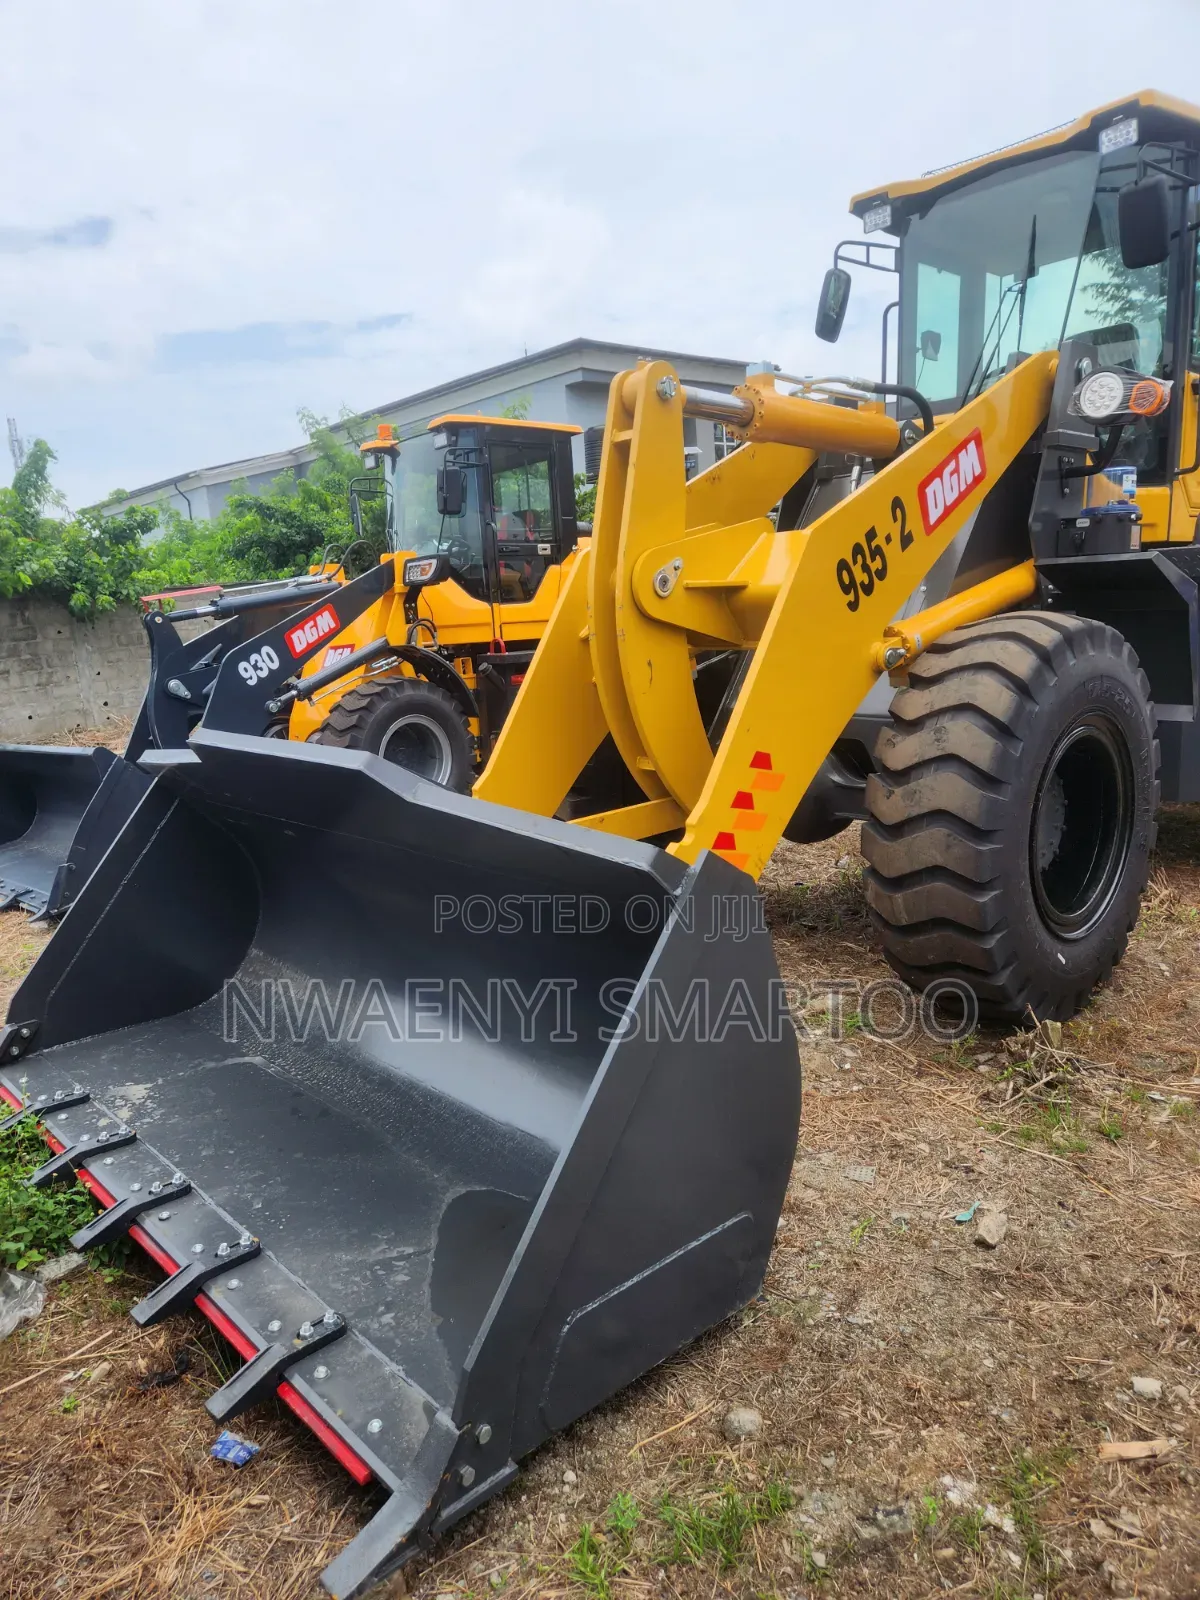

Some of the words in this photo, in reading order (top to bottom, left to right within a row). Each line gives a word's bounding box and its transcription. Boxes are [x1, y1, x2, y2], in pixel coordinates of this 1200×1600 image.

[925, 440, 982, 526] DGM
[836, 496, 914, 612] 935-2
[291, 610, 336, 653] DGM
[238, 645, 279, 686] 930
